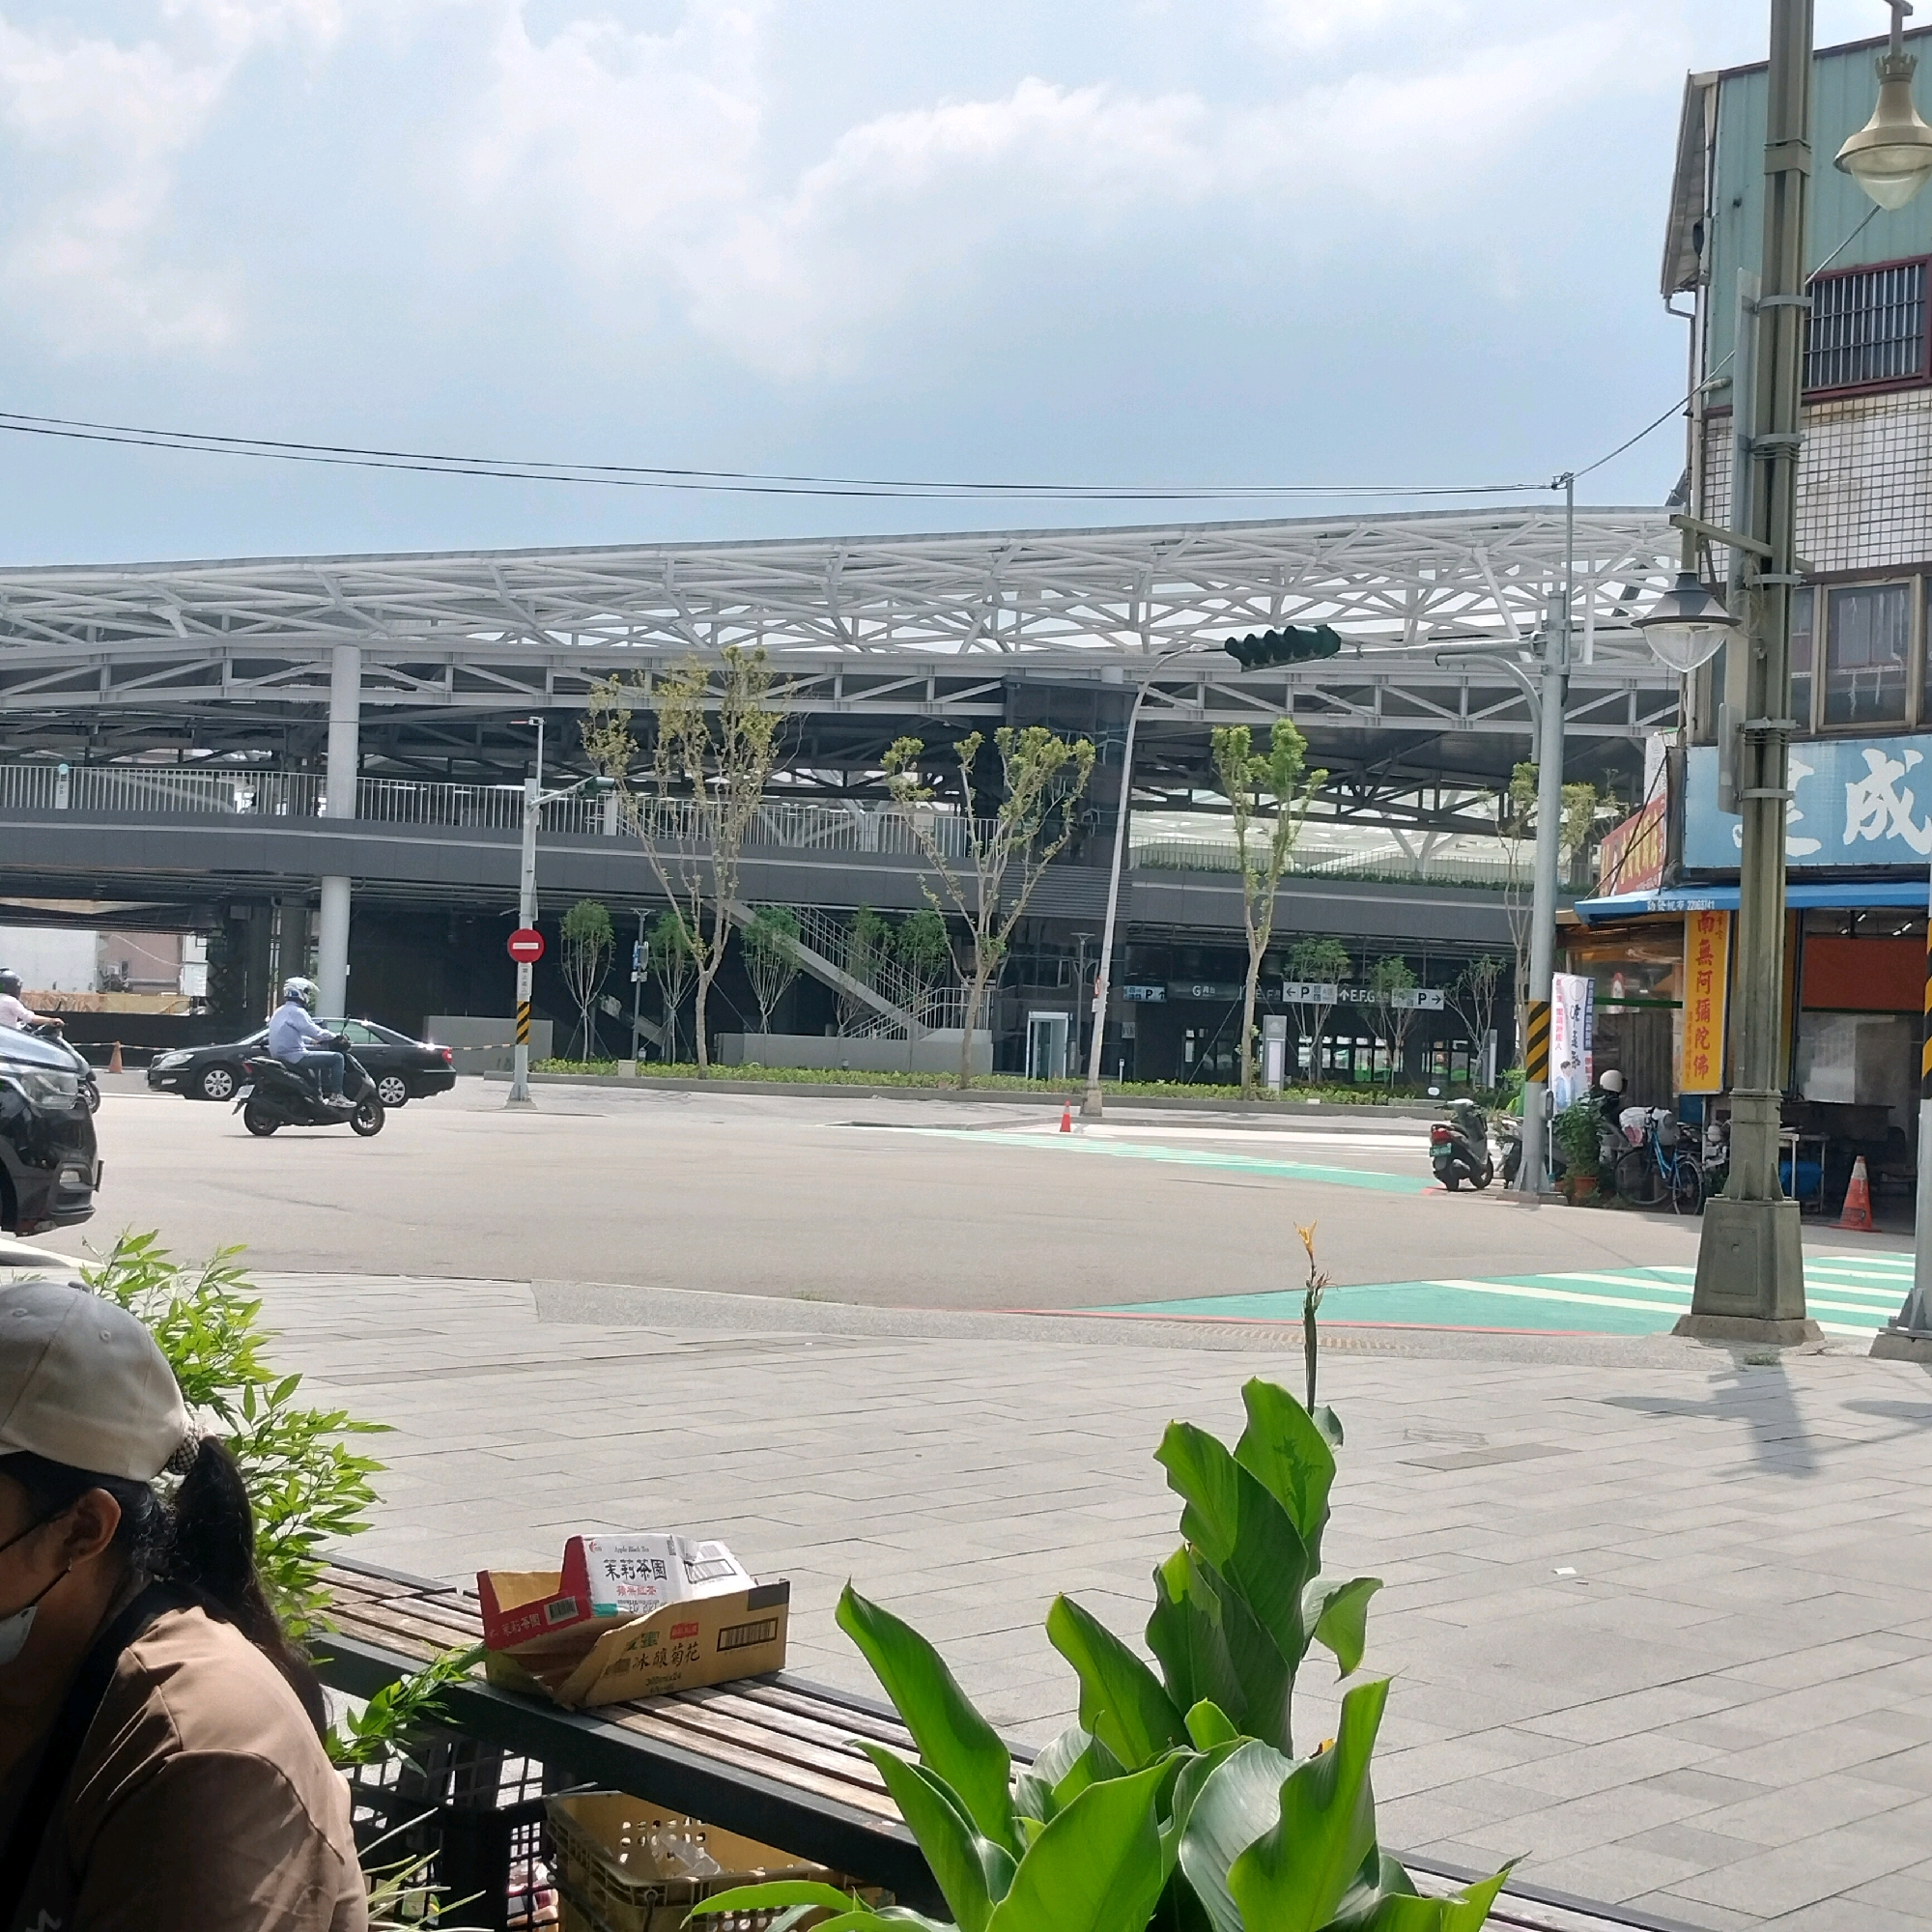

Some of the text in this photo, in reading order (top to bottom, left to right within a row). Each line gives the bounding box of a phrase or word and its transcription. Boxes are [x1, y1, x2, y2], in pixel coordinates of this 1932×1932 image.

[1145, 989, 1153, 1000] P
[1192, 985, 1201, 997] G
[1301, 986, 1310, 999] P
[1693, 911, 1716, 1080] 南無阿彌陀佛
[1417, 992, 1427, 1005] P
[603, 1558, 668, 1581] 茉莉茶園
